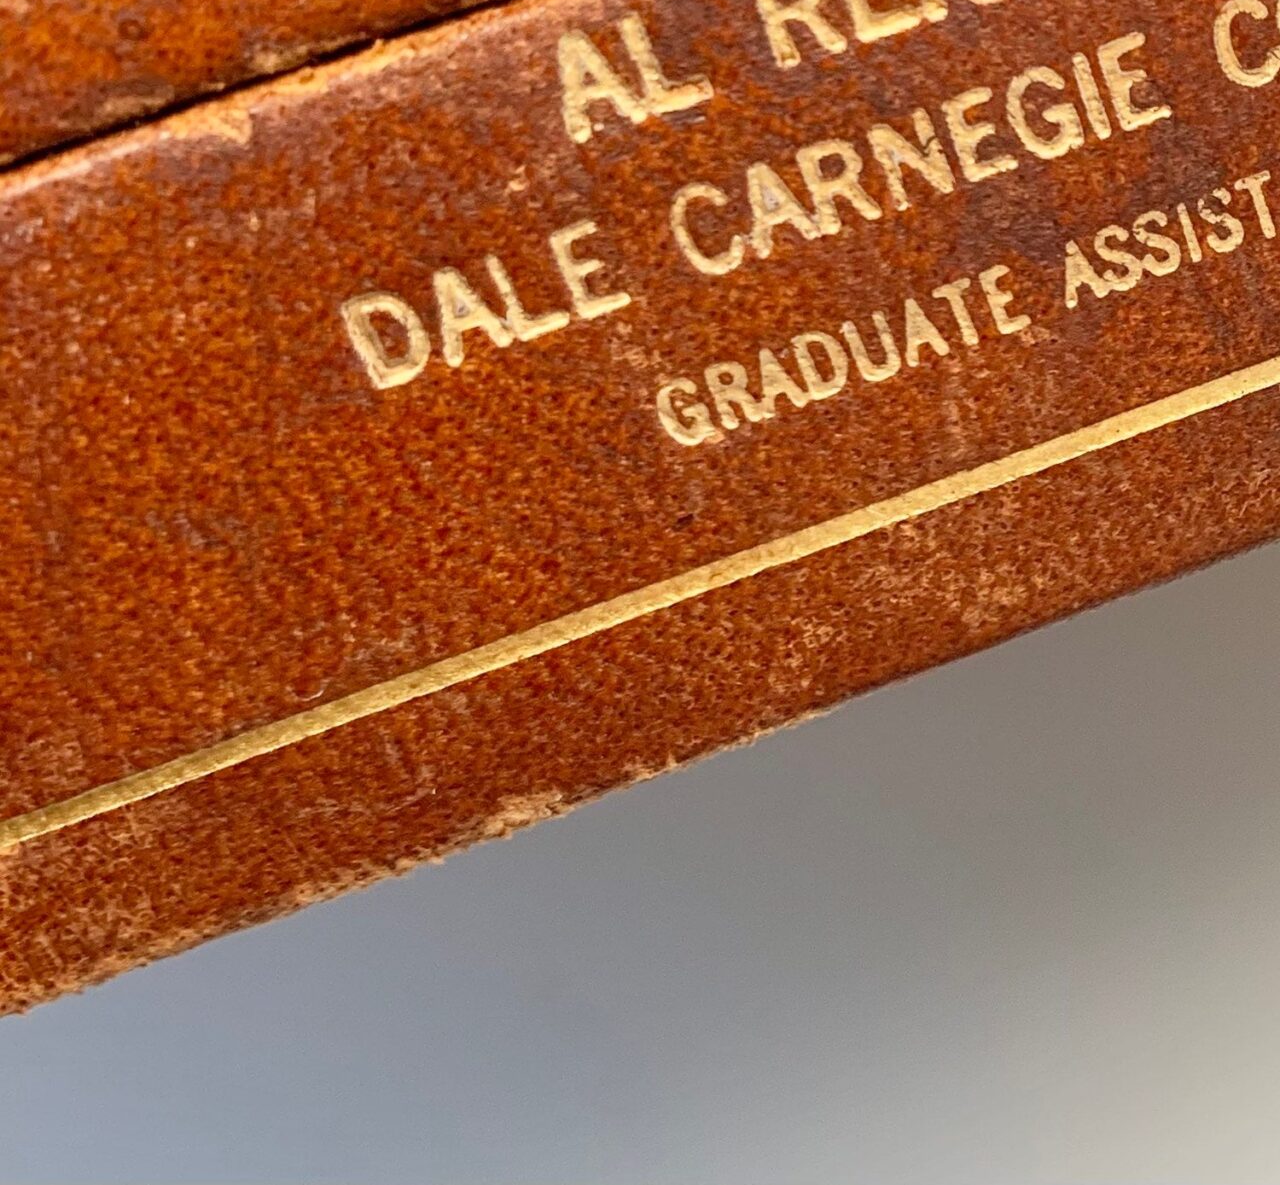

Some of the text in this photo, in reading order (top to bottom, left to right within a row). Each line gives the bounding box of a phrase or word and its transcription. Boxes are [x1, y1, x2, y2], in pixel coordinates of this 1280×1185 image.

[555, 10, 715, 143] AL
[340, 220, 632, 390] DALE
[669, 31, 1172, 275] CARNEGIE
[655, 264, 1031, 446] GRADUATE
